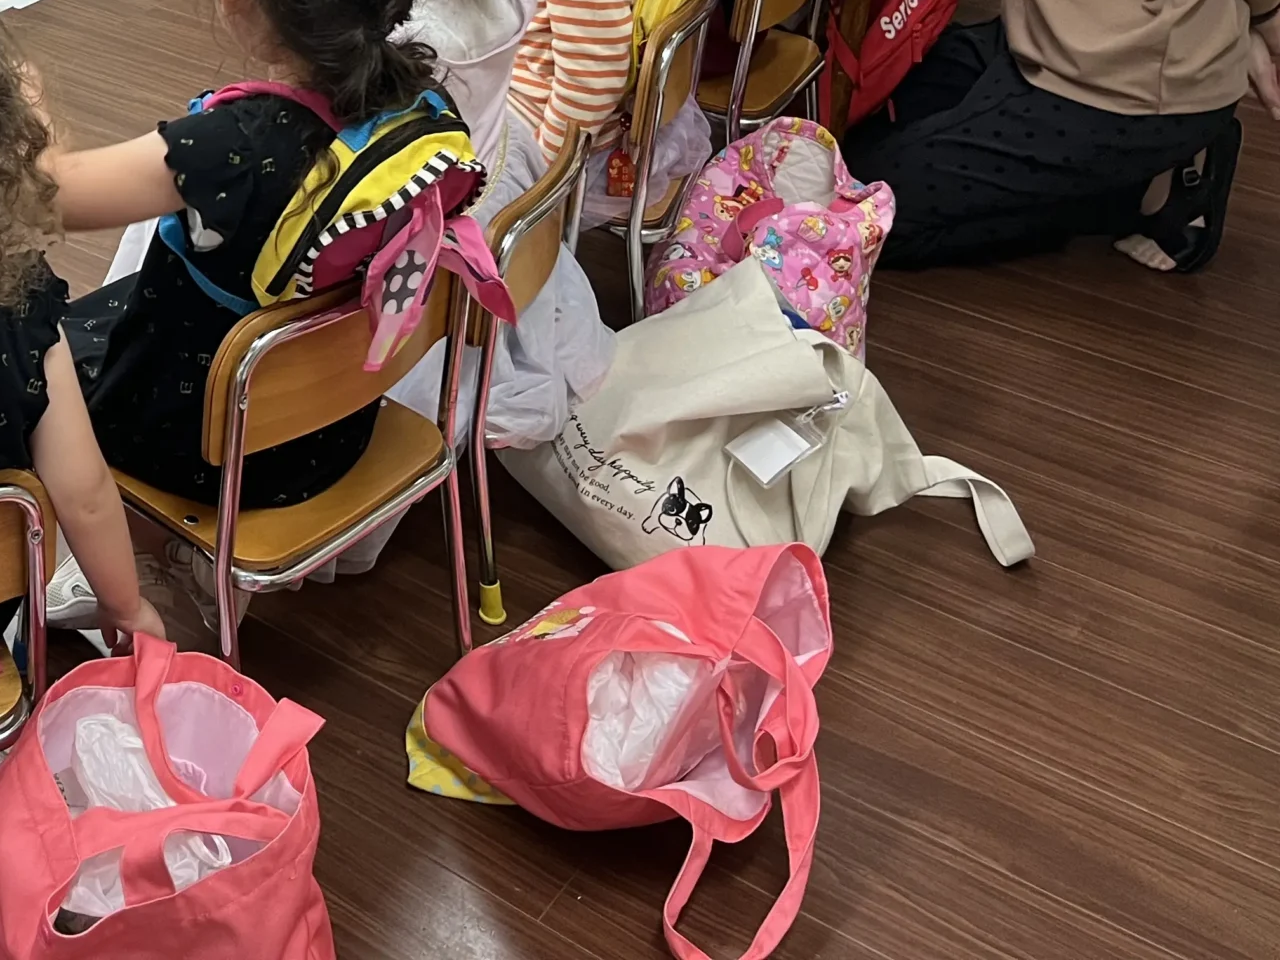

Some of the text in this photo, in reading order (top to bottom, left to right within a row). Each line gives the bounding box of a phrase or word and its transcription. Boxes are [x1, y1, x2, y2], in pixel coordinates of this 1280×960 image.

[579, 470, 590, 481] be
[589, 480, 610, 494] good,
[588, 448, 607, 471] day
[607, 458, 656, 494] happily
[580, 486, 591, 498] in
[591, 494, 615, 511] every
[616, 506, 636, 520] day.
